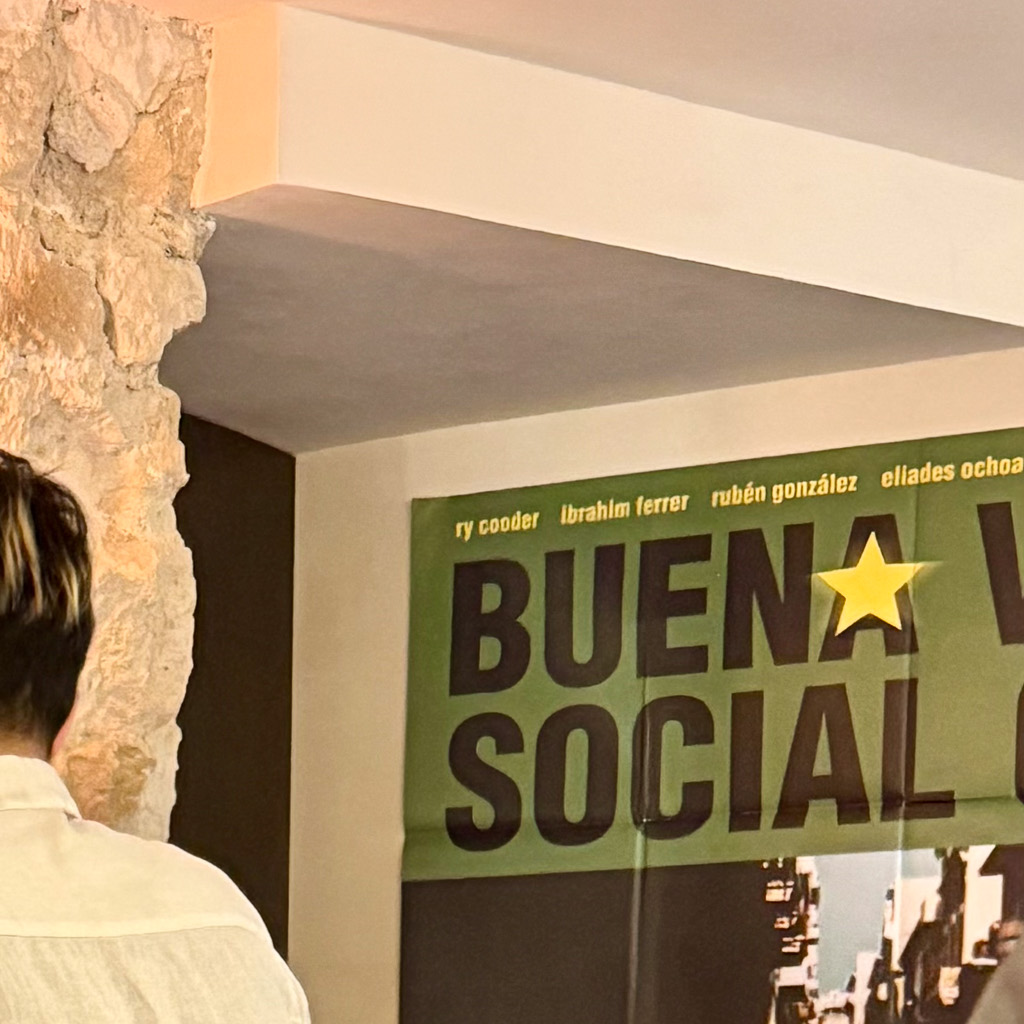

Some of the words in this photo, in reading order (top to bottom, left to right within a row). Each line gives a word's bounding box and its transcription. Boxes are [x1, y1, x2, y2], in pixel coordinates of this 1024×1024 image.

[455, 518, 474, 542] ry
[478, 510, 540, 536] cooder
[635, 494, 690, 517] ferrer
[711, 481, 766, 508] rubén
[772, 473, 858, 504] gonzález
[881, 461, 955, 488] eliades
[960, 455, 1024, 481] ochoa
[449, 512, 920, 698] BUENA
[445, 676, 957, 853] SOCIAL
